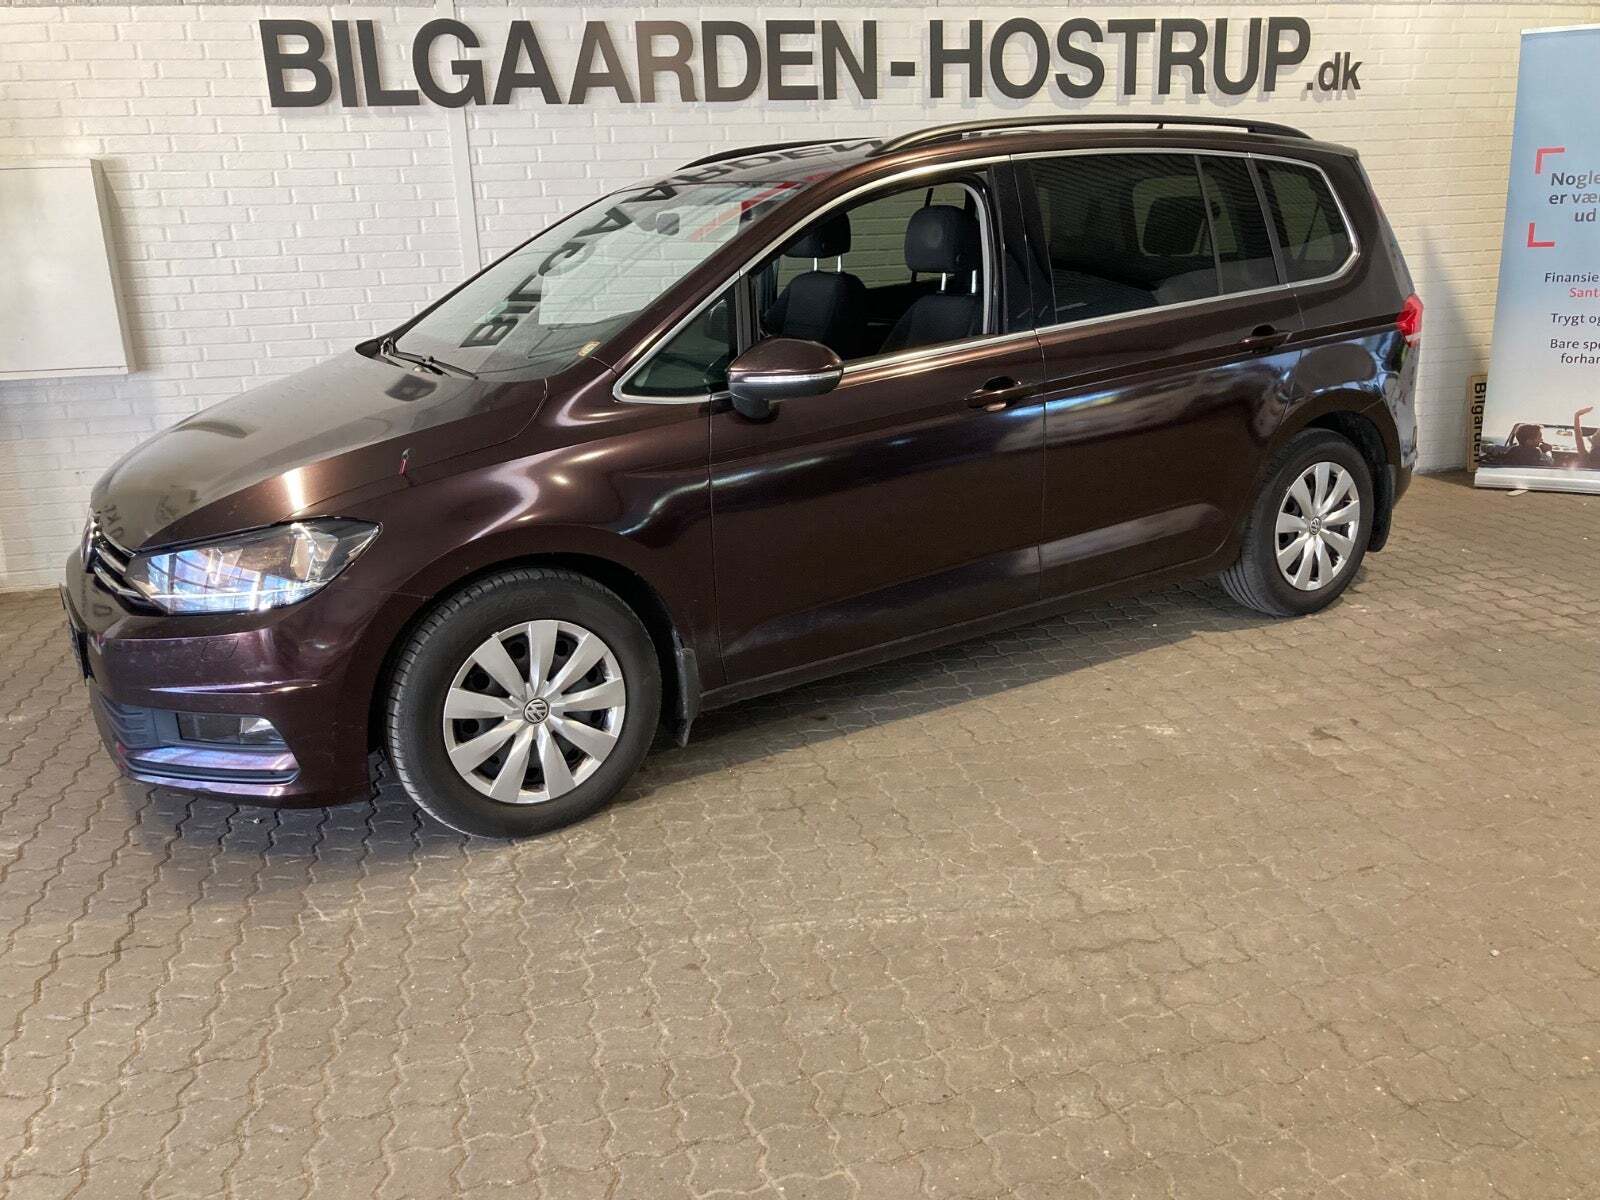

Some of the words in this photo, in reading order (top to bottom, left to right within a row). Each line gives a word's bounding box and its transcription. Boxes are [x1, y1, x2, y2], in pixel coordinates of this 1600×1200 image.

[1551, 170, 1600, 189] Nogle
[1549, 194, 1567, 205] er
[1572, 193, 1600, 204] væ
[1575, 208, 1596, 222] ud
[1545, 272, 1600, 283] Finansie
[1569, 288, 1600, 298] Sant
[1551, 313, 1585, 327] Trygt
[1551, 339, 1580, 349] Bare
[1584, 341, 1600, 351] sp
